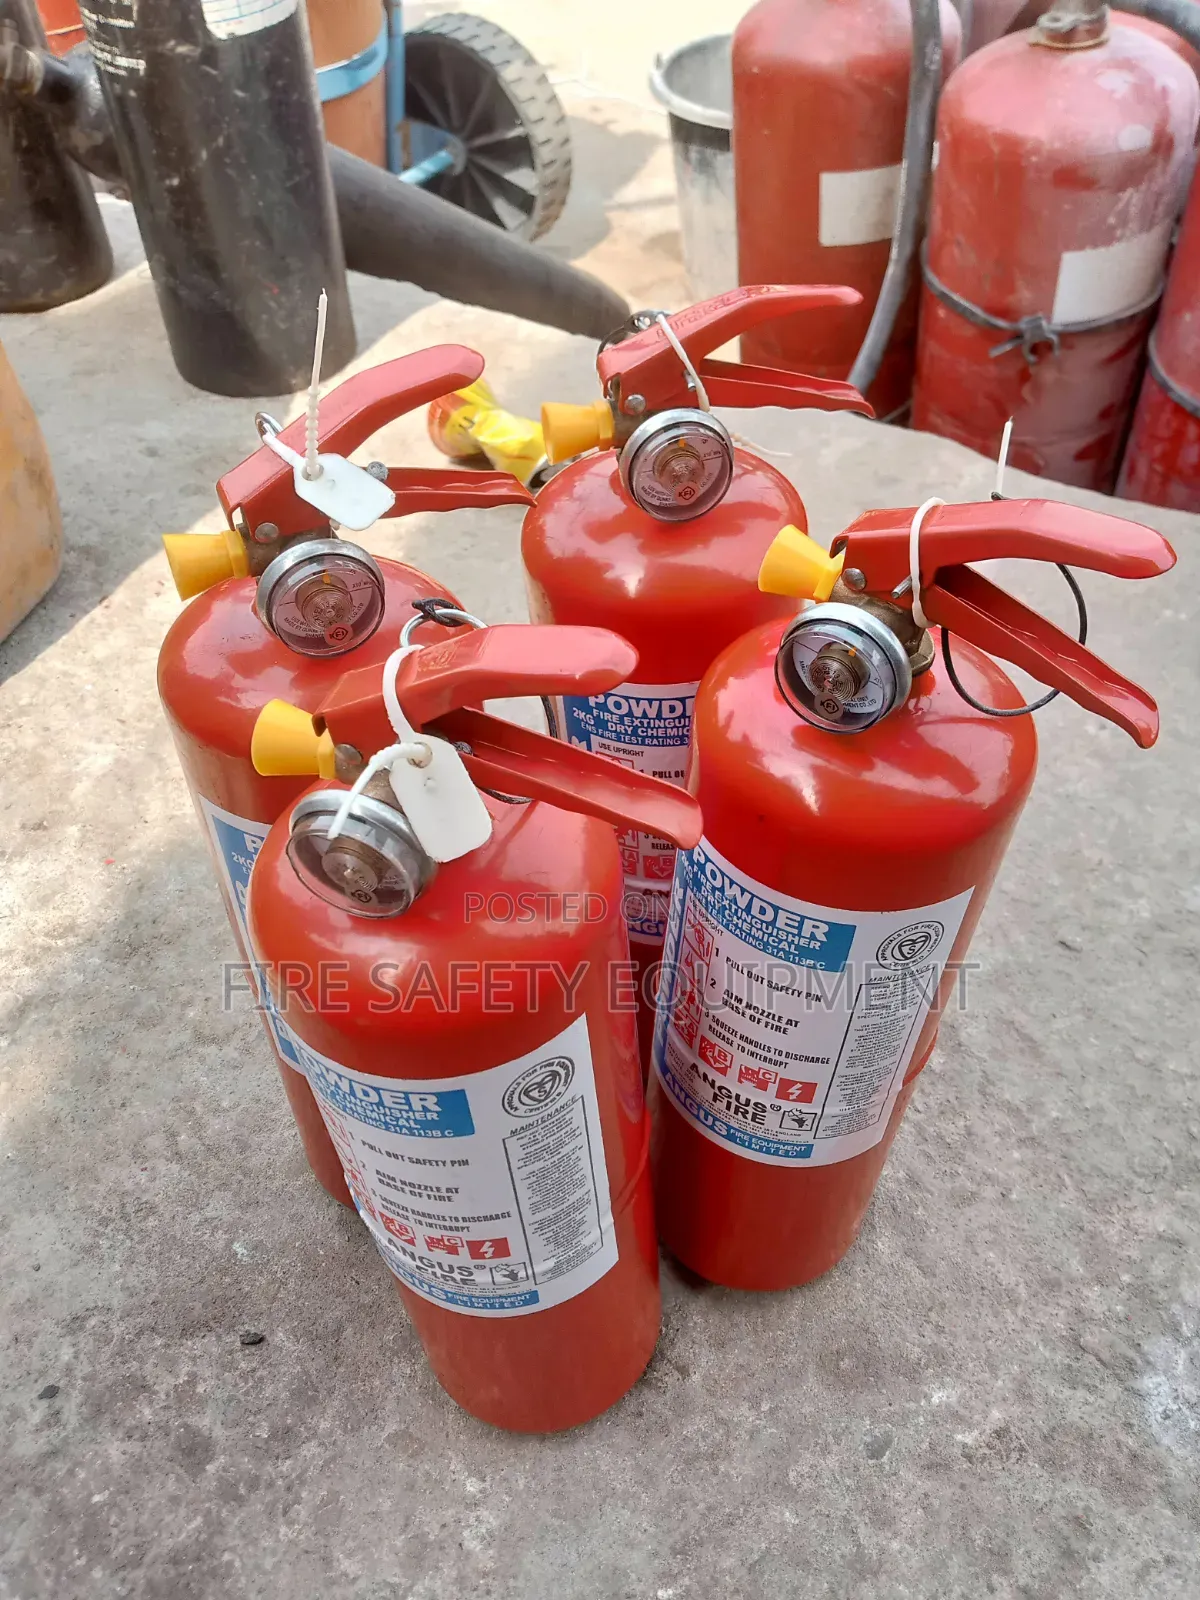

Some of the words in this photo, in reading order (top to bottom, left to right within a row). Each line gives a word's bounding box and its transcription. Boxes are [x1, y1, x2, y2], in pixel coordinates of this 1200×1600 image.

[572, 707, 595, 725] 2KG
[593, 708, 620, 723] FIRE
[581, 721, 597, 734] ENS
[598, 729, 618, 741] FIRE
[620, 735, 642, 744] TEST
[645, 737, 681, 745] RATING
[608, 722, 633, 734] DRY
[598, 741, 612, 752] USE
[613, 746, 645, 757] UPRIGHT
[652, 770, 673, 778] PULL
[693, 845, 829, 942] POWDER
[693, 864, 712, 893] FIRE
[715, 887, 821, 951] EXTINGUISHER
[698, 910, 725, 937] UPRIGHT
[701, 886, 722, 910] DRY
[725, 910, 799, 955] CHEMICAL
[903, 925, 919, 934] FOR
[729, 925, 763, 950] RATING
[766, 945, 785, 959] 31A
[788, 954, 814, 967] 113B
[714, 947, 720, 957] 1
[725, 956, 745, 976] PULL
[746, 970, 765, 985] OUT
[767, 979, 803, 998] SAFETY
[805, 992, 824, 1003] PIN
[869, 965, 934, 983] MAINTENANCE
[710, 978, 717, 990] 2
[722, 988, 744, 1005] AIM
[744, 1002, 784, 1024] NOZZLE
[786, 1019, 801, 1028] AT
[749, 1012, 763, 1026] OF
[764, 1020, 789, 1036] FIRE
[708, 1024, 734, 1048] RELEASE
[737, 1044, 746, 1054] TO
[747, 1049, 789, 1070] INTERRUPT
[711, 1015, 739, 1039] SQUEEZE
[739, 1034, 772, 1054] HANDLES
[773, 1047, 784, 1057] TO
[785, 1051, 831, 1065] DISCHARGE
[717, 1049, 730, 1064] B
[521, 1068, 538, 1081] FOR
[761, 1070, 774, 1082] C
[689, 1061, 768, 1114] ANGUS
[509, 1094, 577, 1135] MAINTENANCE
[665, 1072, 728, 1136] ANGUS
[712, 1090, 767, 1126] FIRE
[386, 1124, 409, 1136] 31A
[412, 1129, 442, 1137] 113B
[730, 1128, 750, 1142] FIRE
[752, 1137, 807, 1152] EQUIPMENT
[386, 1150, 405, 1163] OUT
[407, 1155, 447, 1167] SAFETY
[450, 1159, 470, 1167] PIN
[736, 1137, 797, 1157] LIMITED
[360, 1160, 367, 1171] 2
[399, 1179, 442, 1194] NOZZLE
[377, 1177, 405, 1195] BASE
[409, 1190, 425, 1199] OF
[427, 1194, 455, 1202] FIRE
[381, 1203, 410, 1222] RELEASE
[413, 1218, 423, 1226] TO
[425, 1220, 470, 1233] INTERRUPT
[410, 1208, 447, 1222] HANDLES
[461, 1211, 512, 1223] DISCHARGE
[447, 1237, 459, 1246] C
[387, 1237, 474, 1277] ANGUS
[415, 1264, 479, 1287] FIRE
[457, 1300, 524, 1308] LIMITED
[469, 1294, 531, 1303] EQUIPMENT
